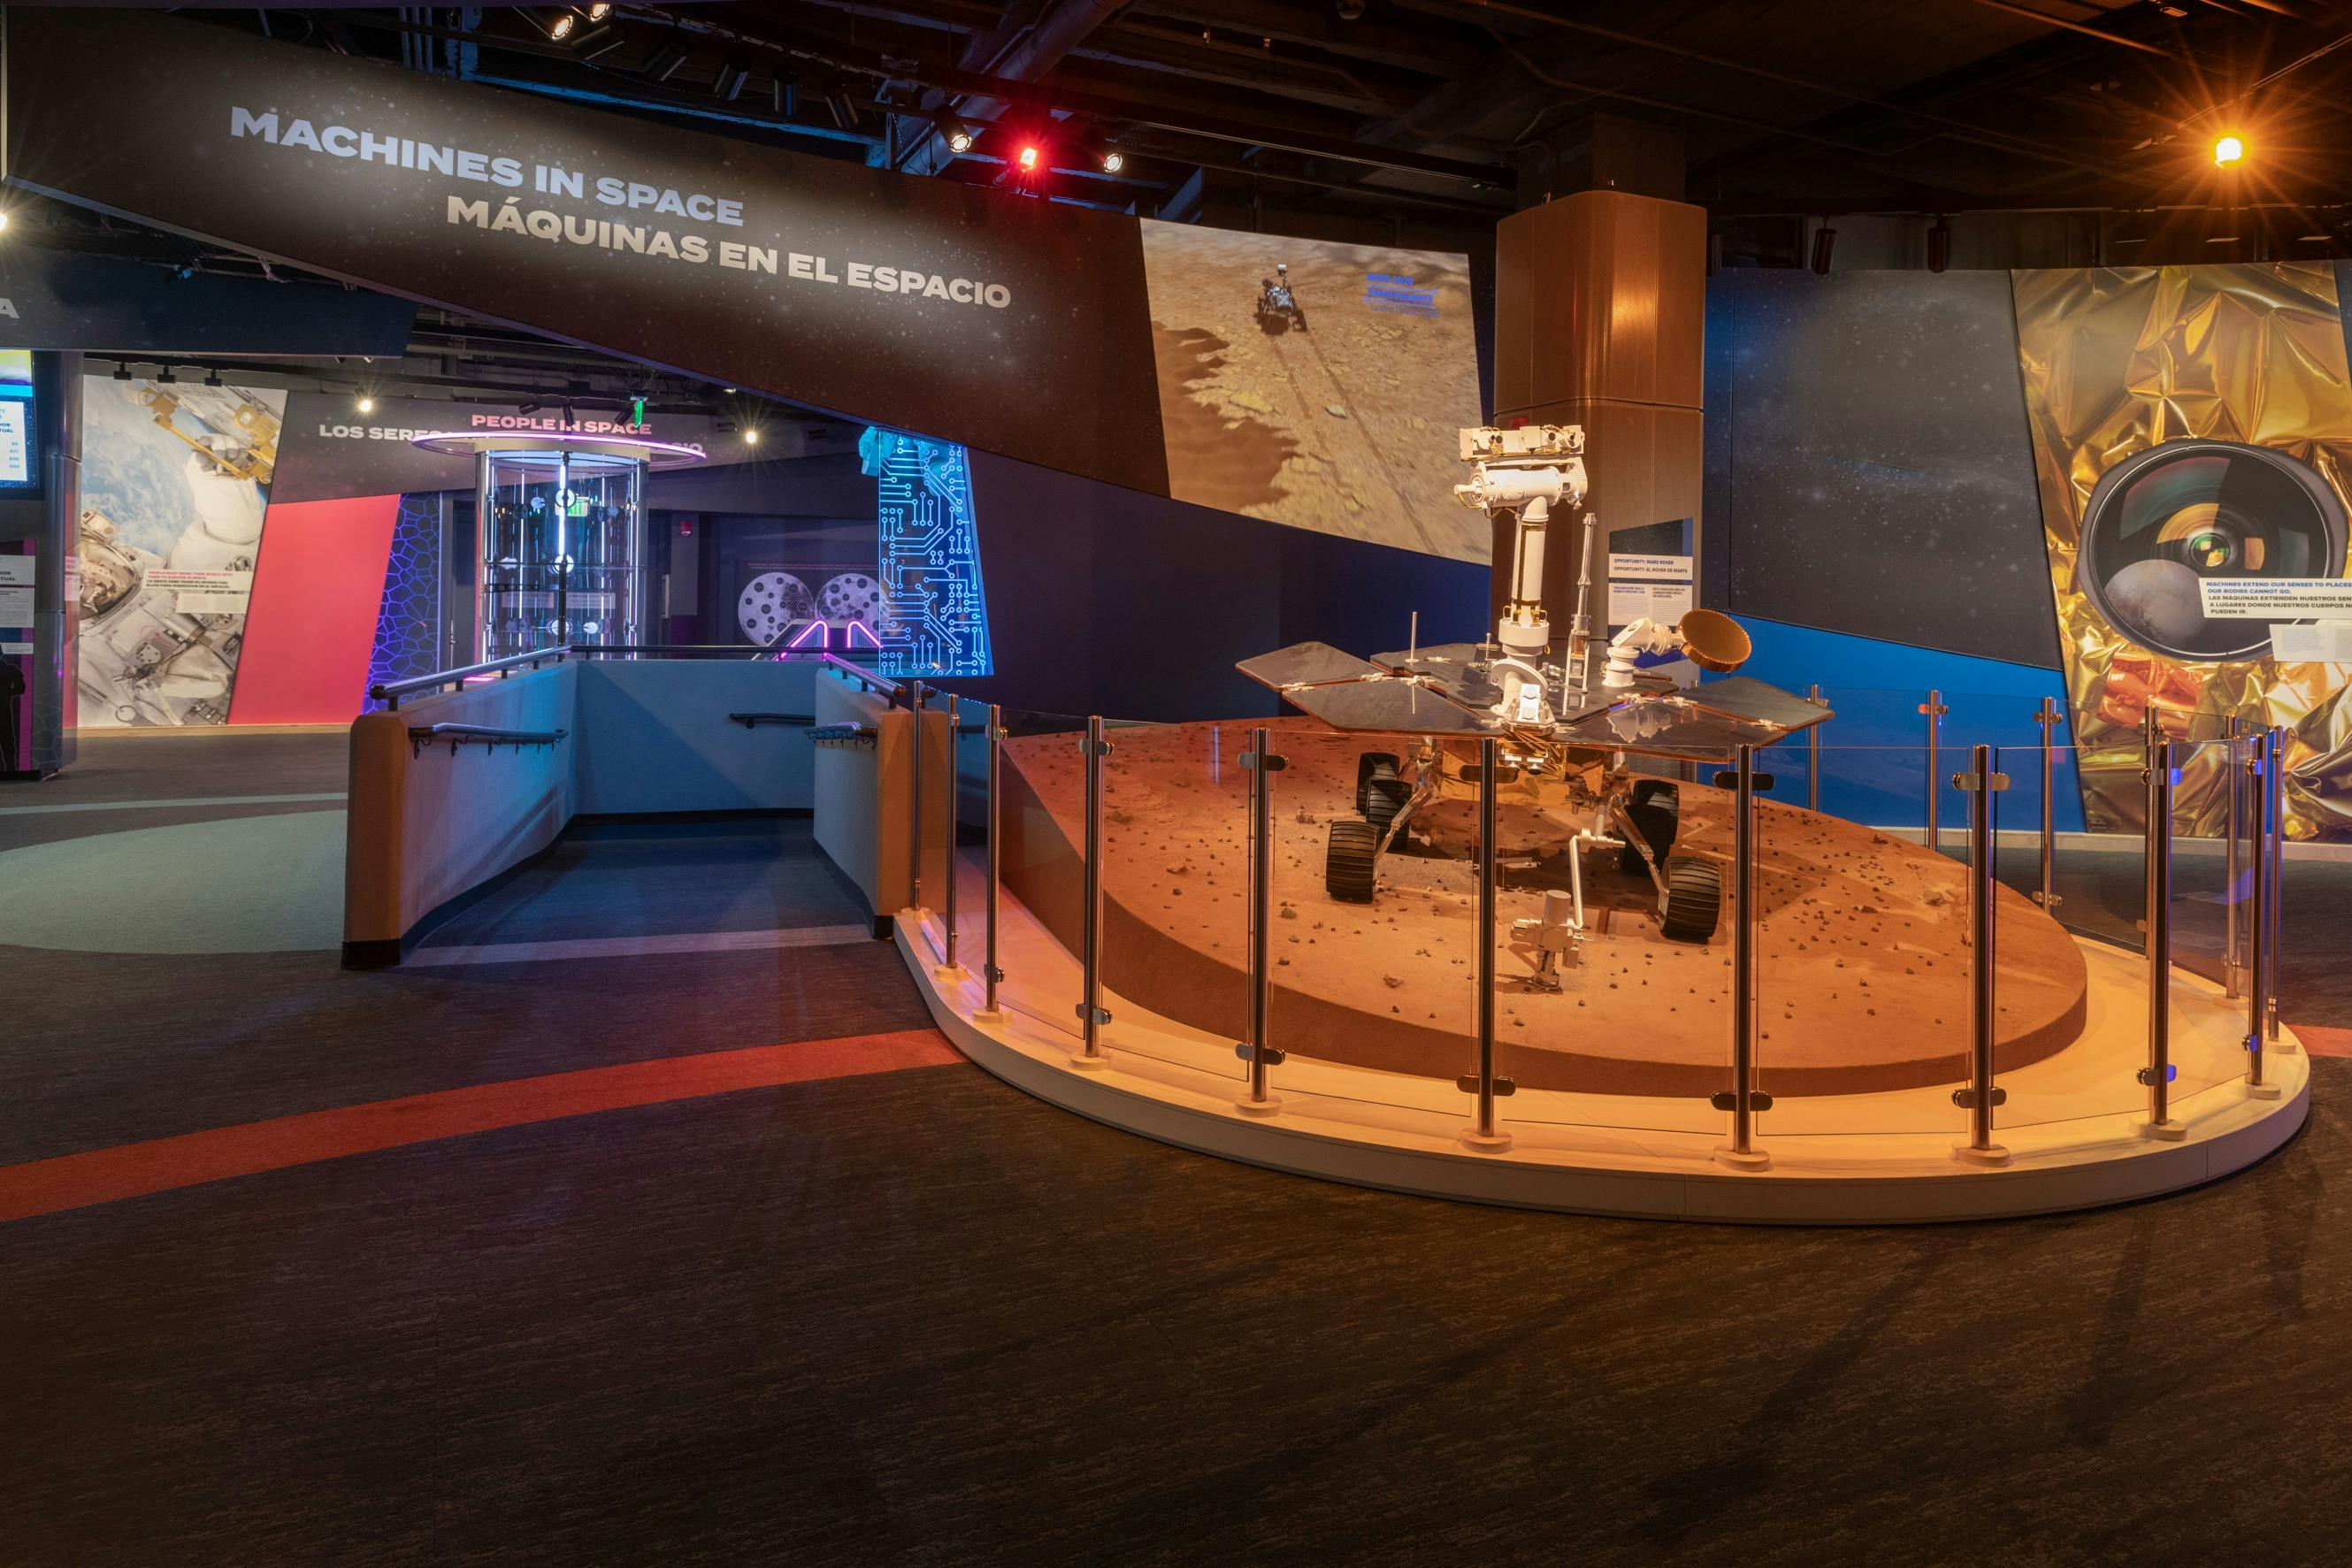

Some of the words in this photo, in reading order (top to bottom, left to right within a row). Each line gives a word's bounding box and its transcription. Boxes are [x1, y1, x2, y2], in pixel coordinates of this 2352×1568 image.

[231, 106, 524, 187] MACHINES
[535, 164, 584, 199] IN
[595, 177, 744, 227] SPACE
[447, 195, 711, 264] MÁQUINAS
[719, 241, 778, 275] EN
[788, 252, 839, 285] EL
[847, 264, 1011, 309] ESPACIO
[319, 425, 364, 439] LOS
[471, 414, 555, 432] PEOPLE
[559, 420, 581, 432] IN
[585, 421, 652, 435] SPACE
